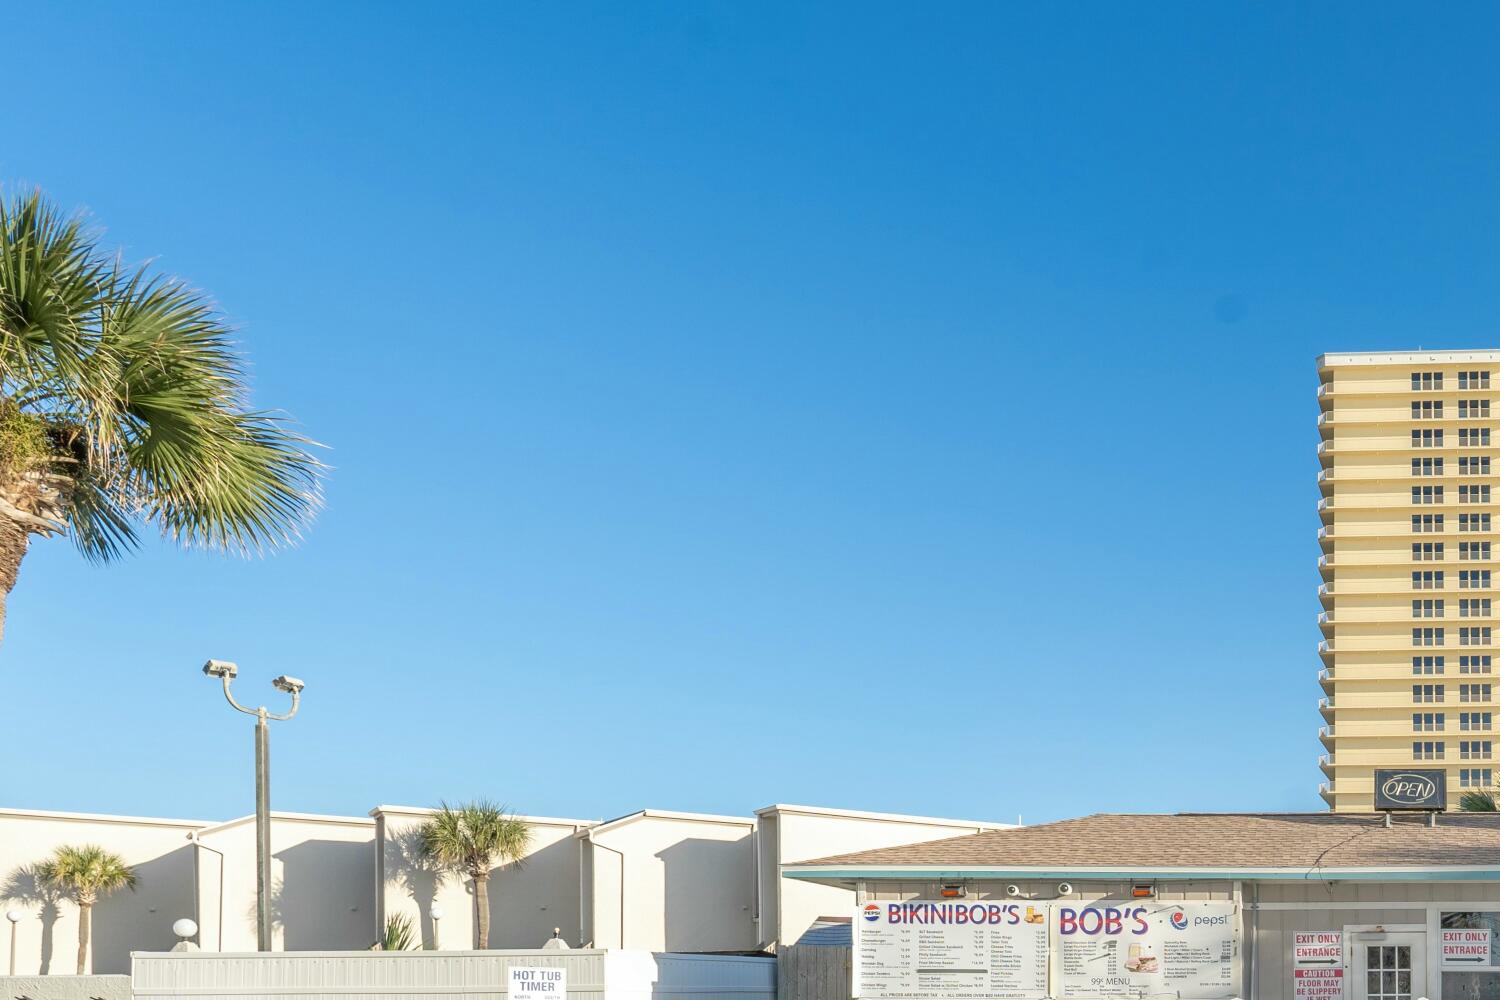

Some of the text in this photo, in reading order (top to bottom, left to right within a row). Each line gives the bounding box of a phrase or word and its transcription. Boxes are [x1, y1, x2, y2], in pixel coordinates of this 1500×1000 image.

[1386, 781, 1430, 797] OPEN
[888, 903, 1020, 925] BIKINIBOB'S
[1060, 907, 1148, 935] BOB'S
[1194, 914, 1227, 927] pepsi
[1296, 934, 1341, 944] EXIT ONLY
[1443, 932, 1488, 942] EXIT ONLY
[1296, 948, 1341, 957] ENTRANCE
[1443, 946, 1488, 955] ENTRANCE
[513, 970, 561, 981] HOT TUB
[1302, 969, 1335, 978] CAUTION
[1106, 977, 1131, 985] MENU
[520, 981, 555, 992] TIMER
